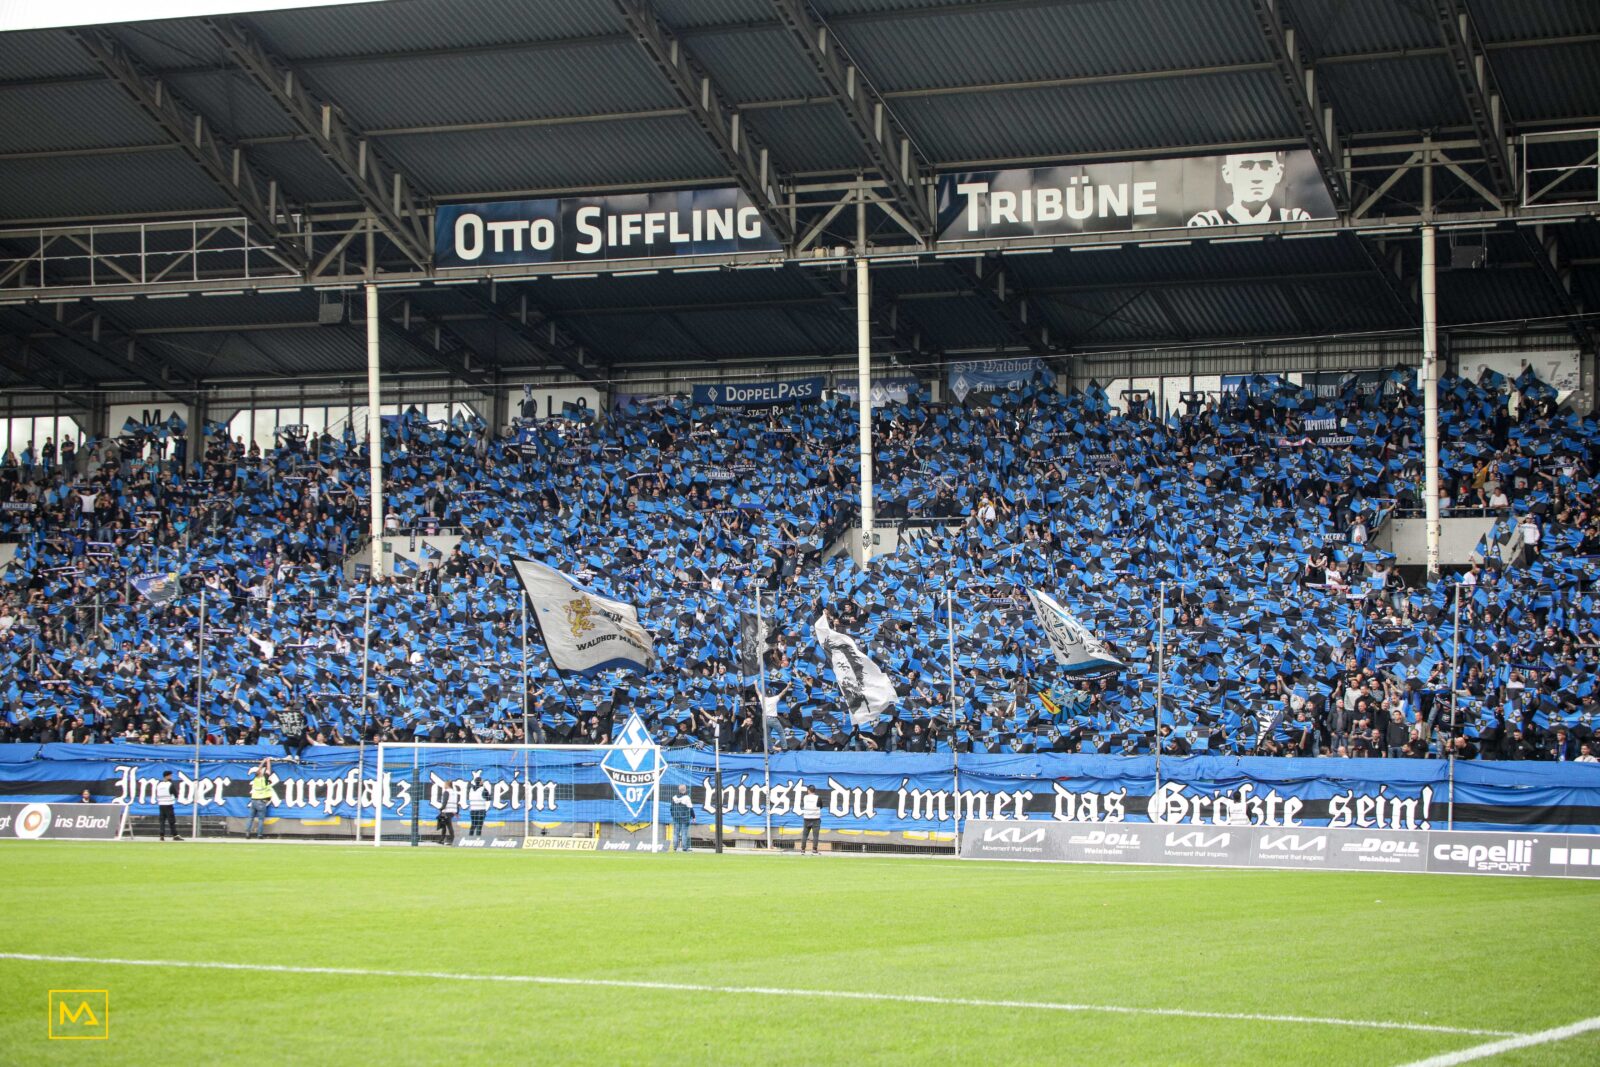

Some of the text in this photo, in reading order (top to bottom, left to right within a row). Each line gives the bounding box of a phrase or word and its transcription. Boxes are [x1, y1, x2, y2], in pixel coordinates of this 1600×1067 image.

[956, 175, 1158, 232] TRIBÜNE
[575, 206, 762, 255] SIFFLING
[575, 634, 617, 651] WALDHOF
[176, 770, 231, 806] der
[828, 775, 876, 819] du
[896, 777, 1034, 822] immer
[1053, 780, 1127, 823] das
[1328, 784, 1433, 830] sein!
[54, 815, 74, 829] ins
[75, 815, 110, 829] Büro!
[458, 836, 517, 849] bwin bwin
[525, 839, 596, 850] SPORTWETTEN
[603, 840, 630, 851] bwin
[1433, 840, 1533, 868] capelli
[1477, 862, 1531, 872] SPORT
